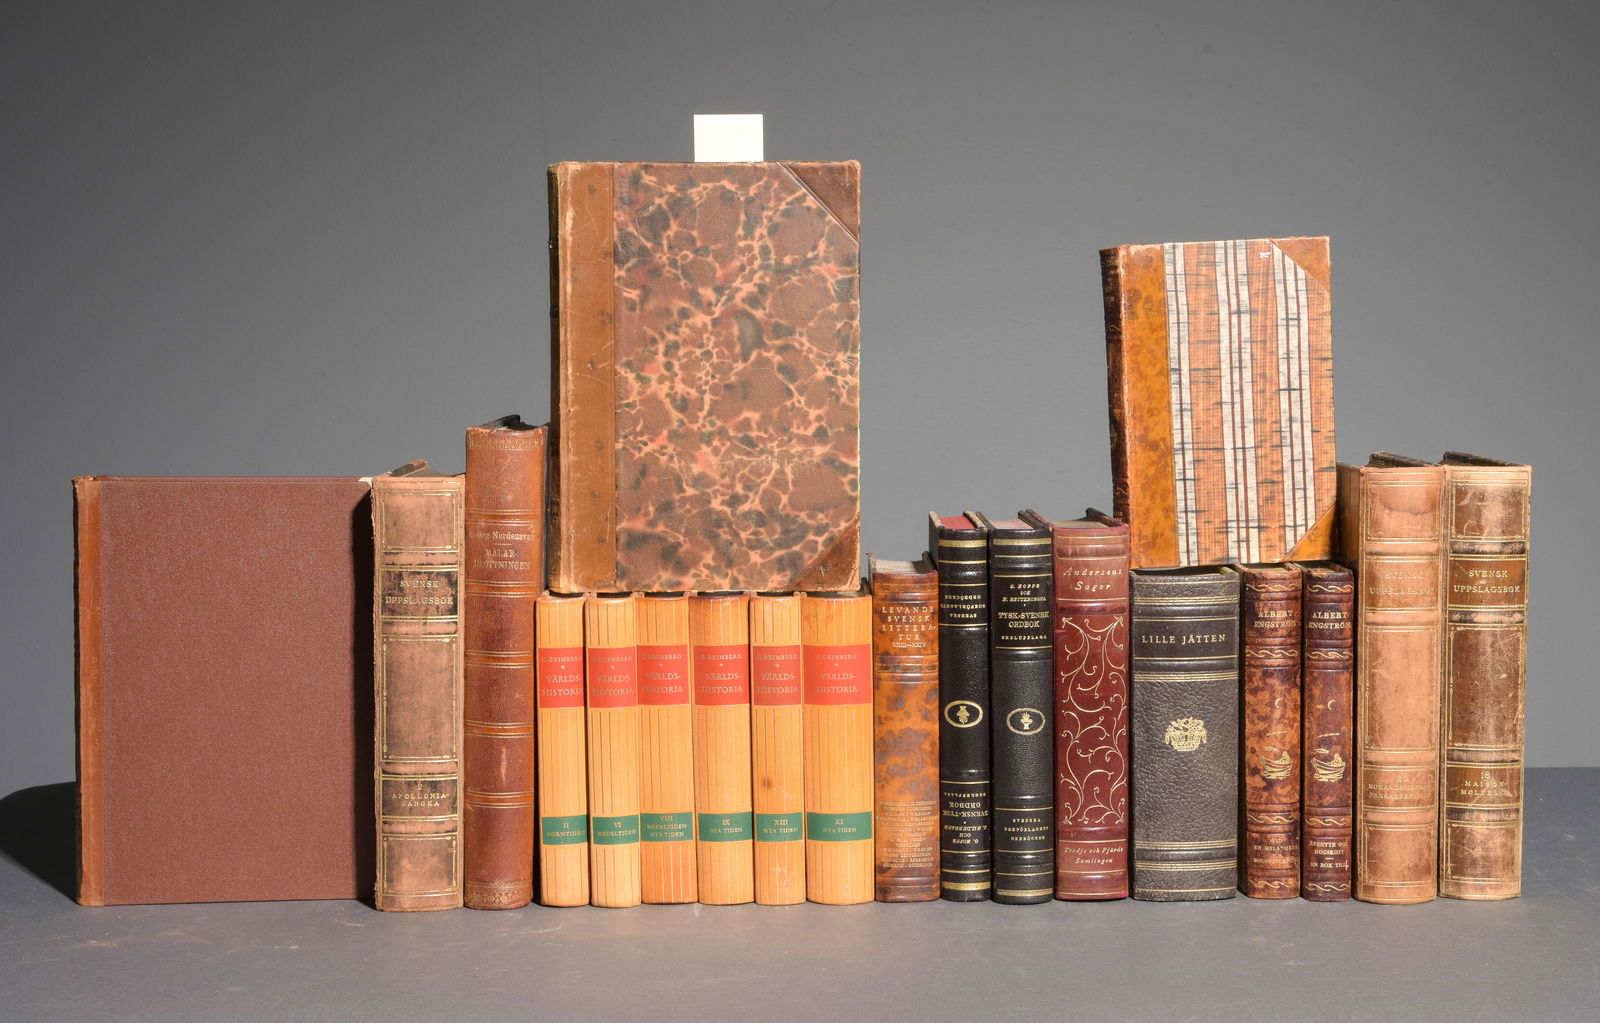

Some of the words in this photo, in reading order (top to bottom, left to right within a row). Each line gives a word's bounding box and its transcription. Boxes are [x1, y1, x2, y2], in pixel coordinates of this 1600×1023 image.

[1063, 566, 1122, 576] Andersens
[1469, 570, 1508, 578] SVENSK
[400, 580, 439, 588] SVENSK
[1074, 581, 1111, 592] Sagor
[1453, 585, 1521, 594] UPPSLAGSBOK
[385, 596, 453, 605] UPPSLAGSBOK
[998, 611, 1050, 619] TYSK-SVENSK
[1258, 609, 1293, 618] ALBERT
[1312, 611, 1348, 619] ALBERT
[1008, 620, 1040, 628] ORDBOK
[1254, 620, 1297, 628] ENGSTRÖM
[1308, 621, 1352, 629] ENGSTRÖM
[898, 633, 920, 641] TUR
[1141, 635, 1176, 644] LILLE
[1181, 633, 1226, 645] JÄTTEN
[542, 688, 583, 696] HISTORIA
[592, 688, 633, 696] HISTORIA
[701, 686, 743, 694] HISTORIA
[757, 686, 798, 694] HISTORIA
[1481, 771, 1491, 779] 18
[1064, 846, 1087, 855] Tredje
[1101, 846, 1124, 855] Fjärde
[1074, 857, 1113, 865] Samlingen
